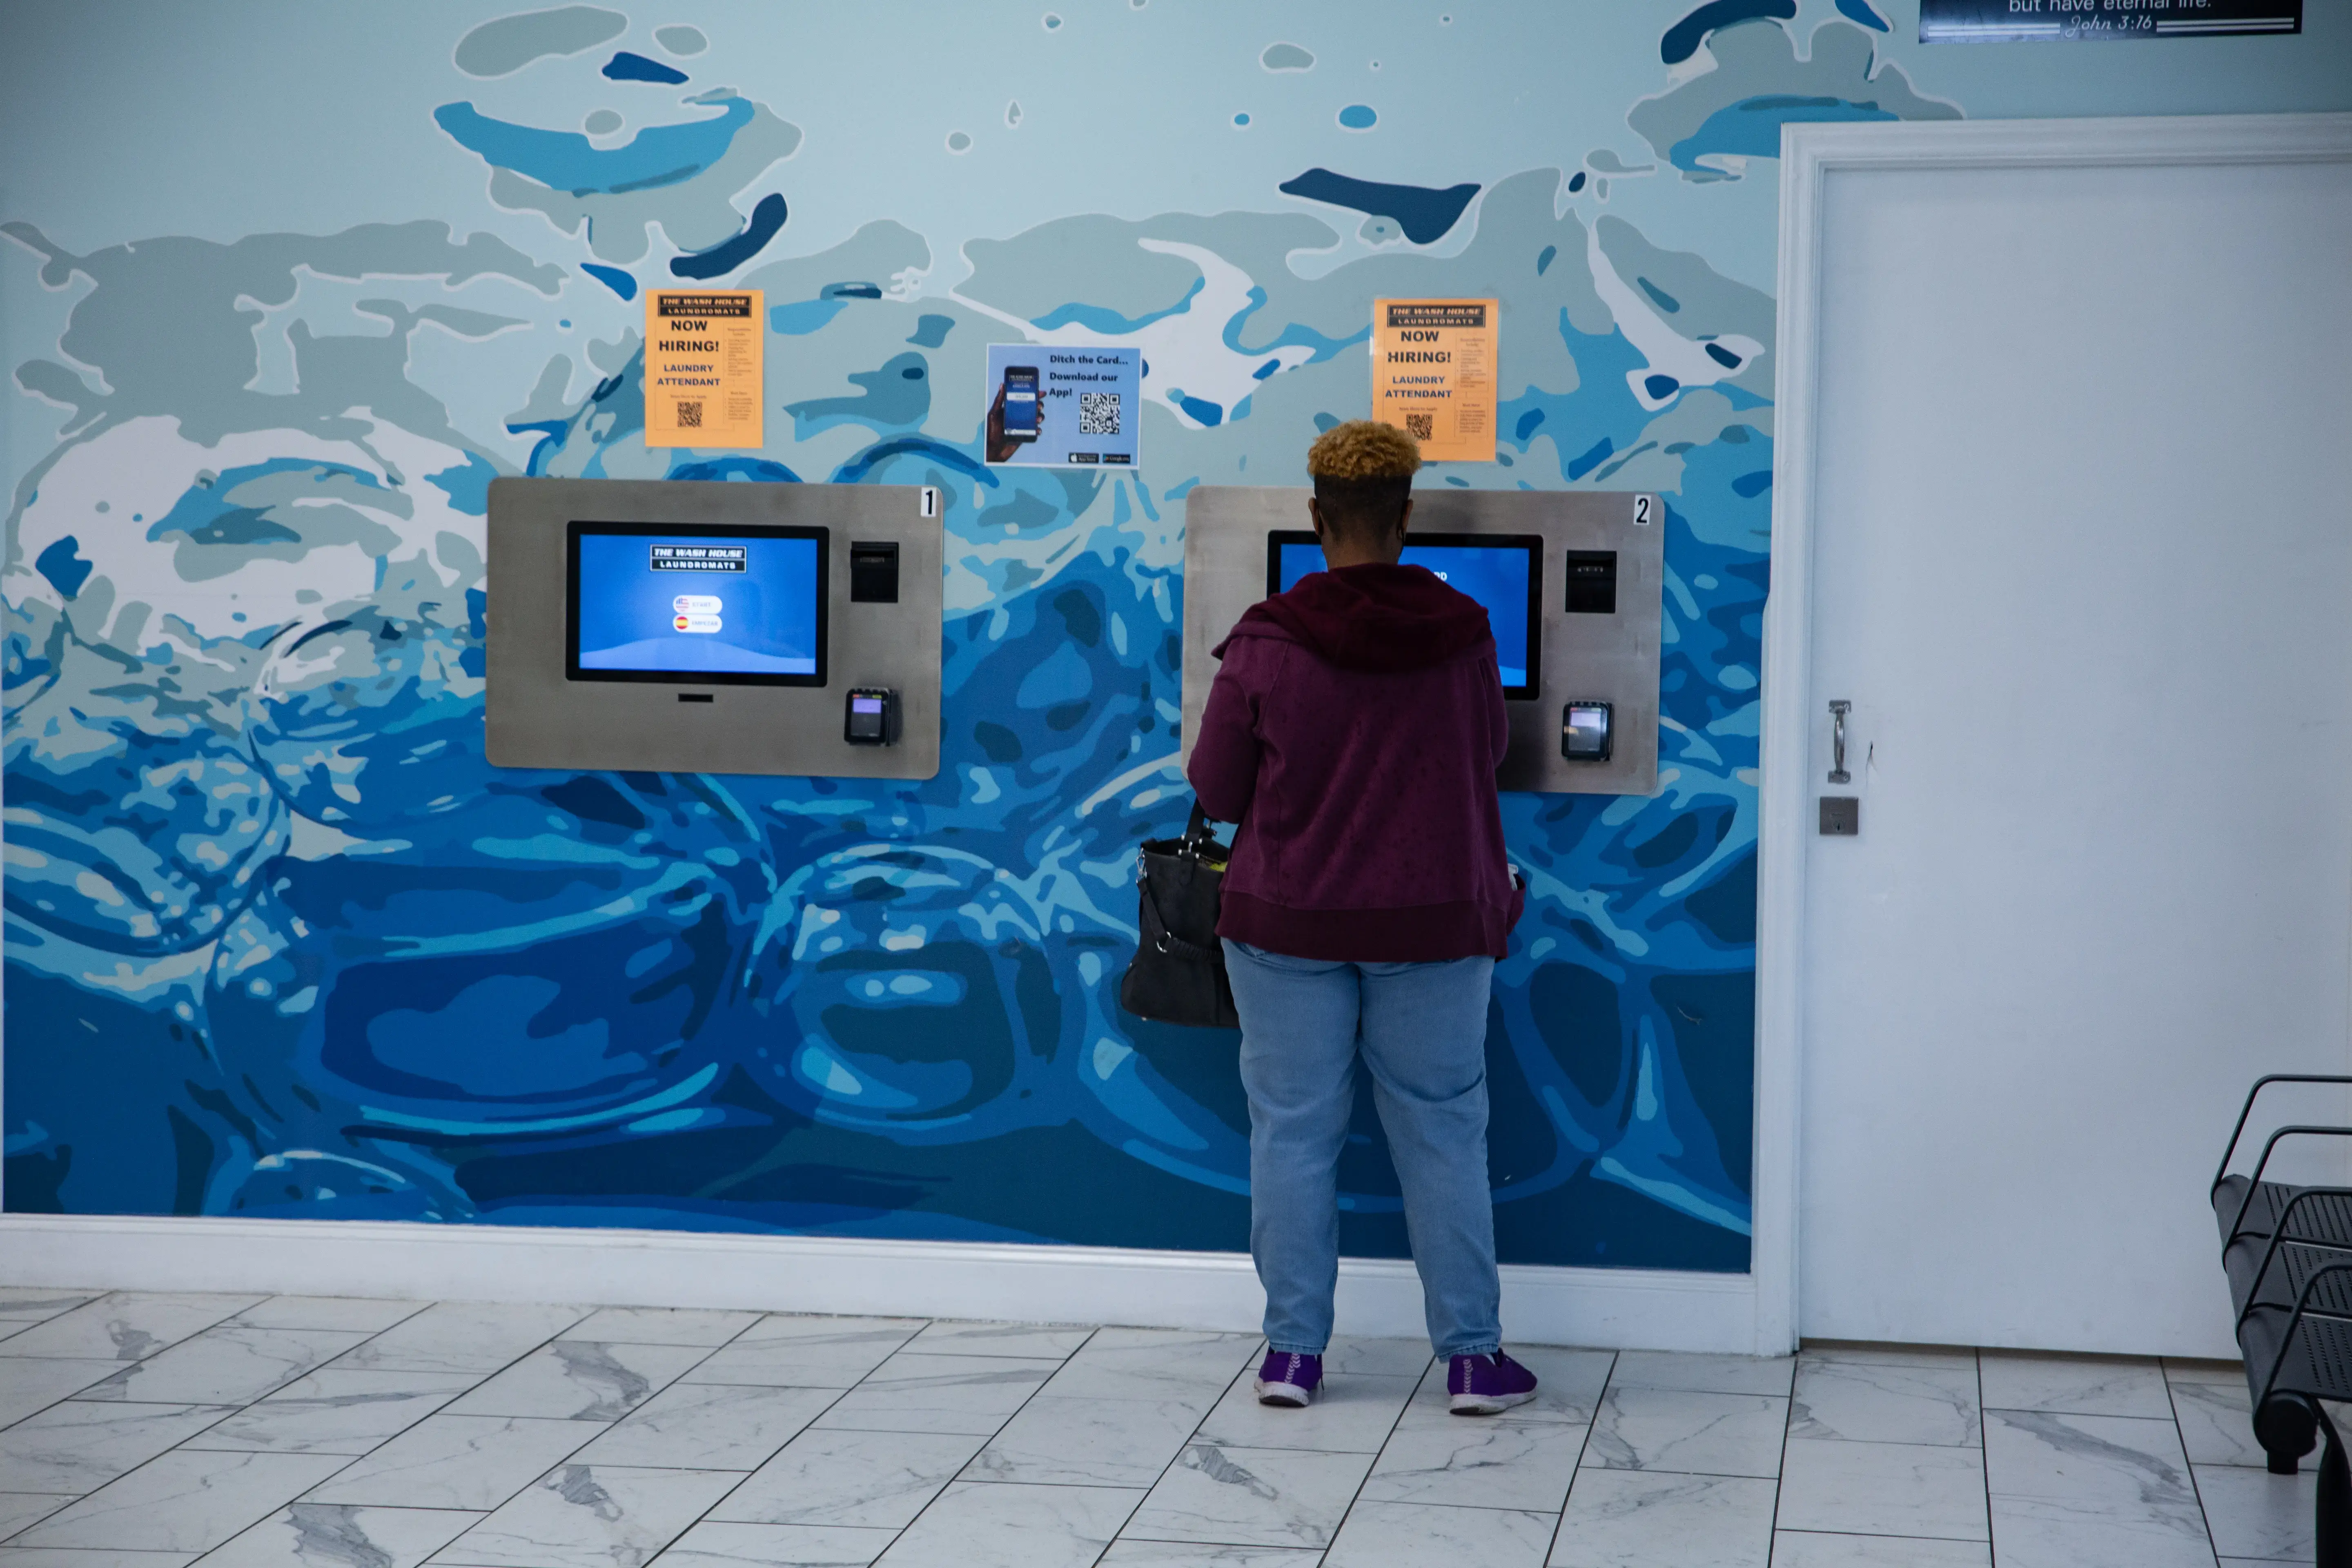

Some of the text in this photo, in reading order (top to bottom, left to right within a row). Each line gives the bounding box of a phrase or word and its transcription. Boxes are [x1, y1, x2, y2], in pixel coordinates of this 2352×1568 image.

[2009, 0, 2041, 12] but
[2049, 0, 2094, 11] have
[2104, 0, 2169, 11] eternal
[2065, 13, 2152, 38] John 3:16
[671, 320, 707, 331] NOW
[1401, 330, 1440, 342] NOW
[659, 341, 719, 352] HIRING!
[1050, 354, 1128, 365] Ditch the Card...
[1388, 352, 1452, 363] HIRING!
[664, 364, 714, 372] LAUNDRY
[657, 378, 721, 386] ATTENDANT
[1049, 372, 1098, 381] Download
[1392, 376, 1446, 384] LAUNDRY
[1049, 388, 1072, 398] App!
[1385, 390, 1452, 398] ATTENDANT
[926, 490, 933, 514] 1
[1636, 498, 1649, 523] 2
[654, 548, 743, 558] THE WASH HOUSE
[660, 561, 735, 569] LAUNDROMATS
